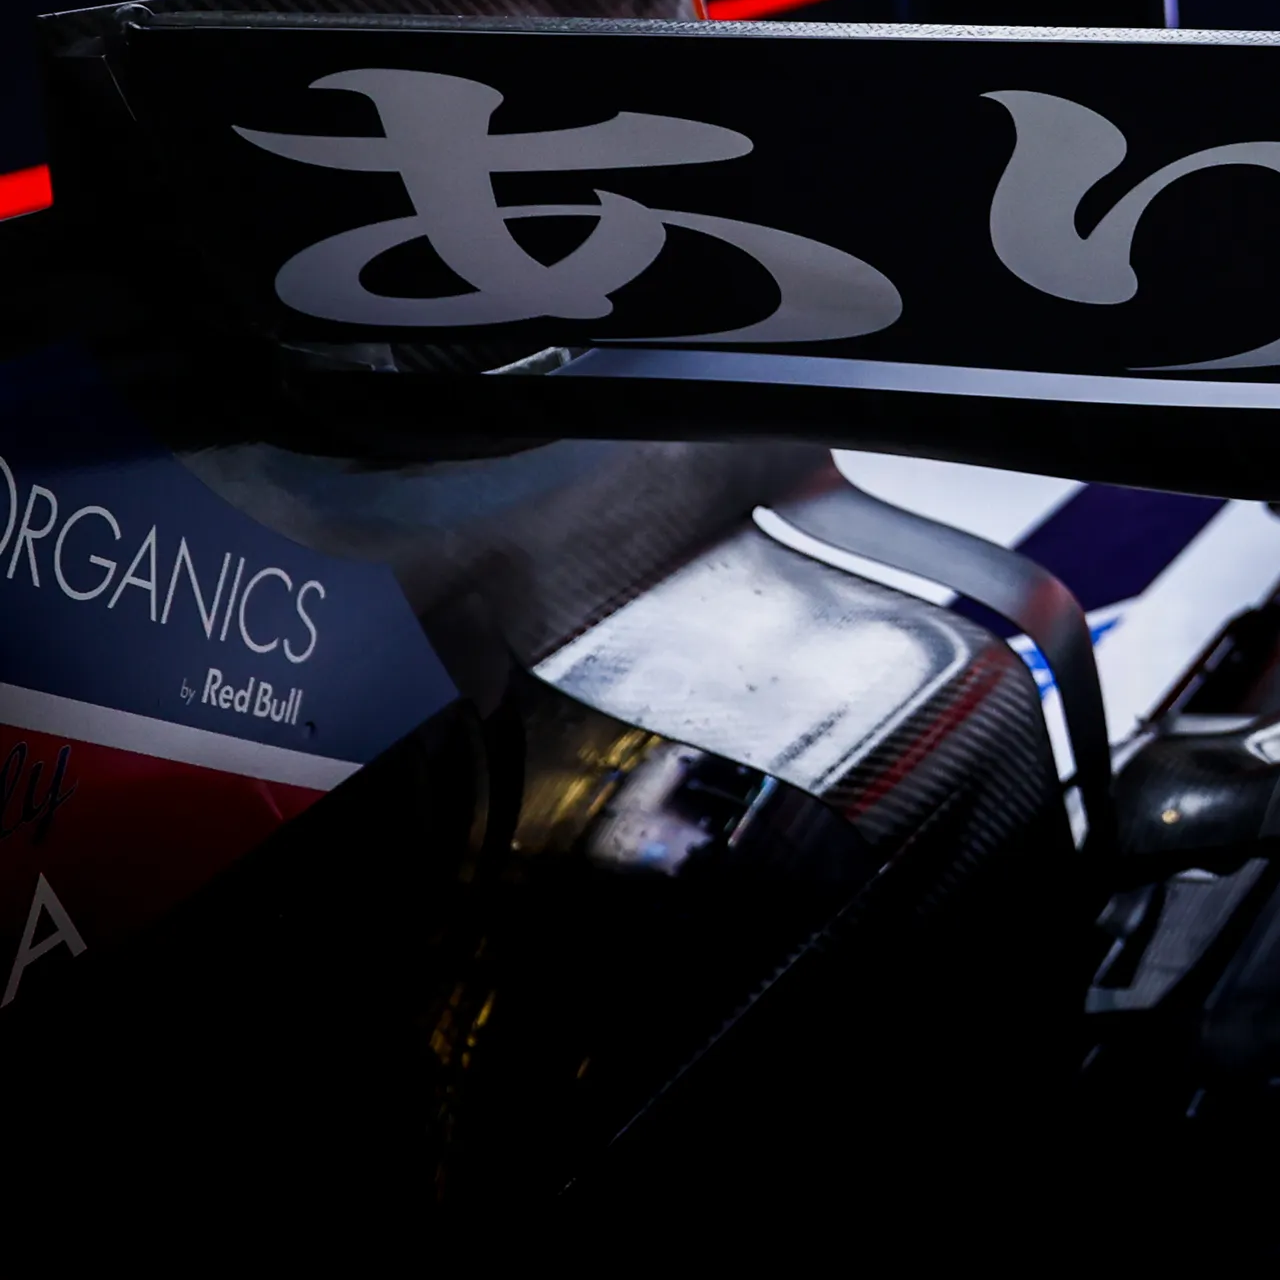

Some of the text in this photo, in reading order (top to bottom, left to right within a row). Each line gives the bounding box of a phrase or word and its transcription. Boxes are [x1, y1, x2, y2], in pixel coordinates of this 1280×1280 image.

[179, 667, 303, 726] by Red Bull
